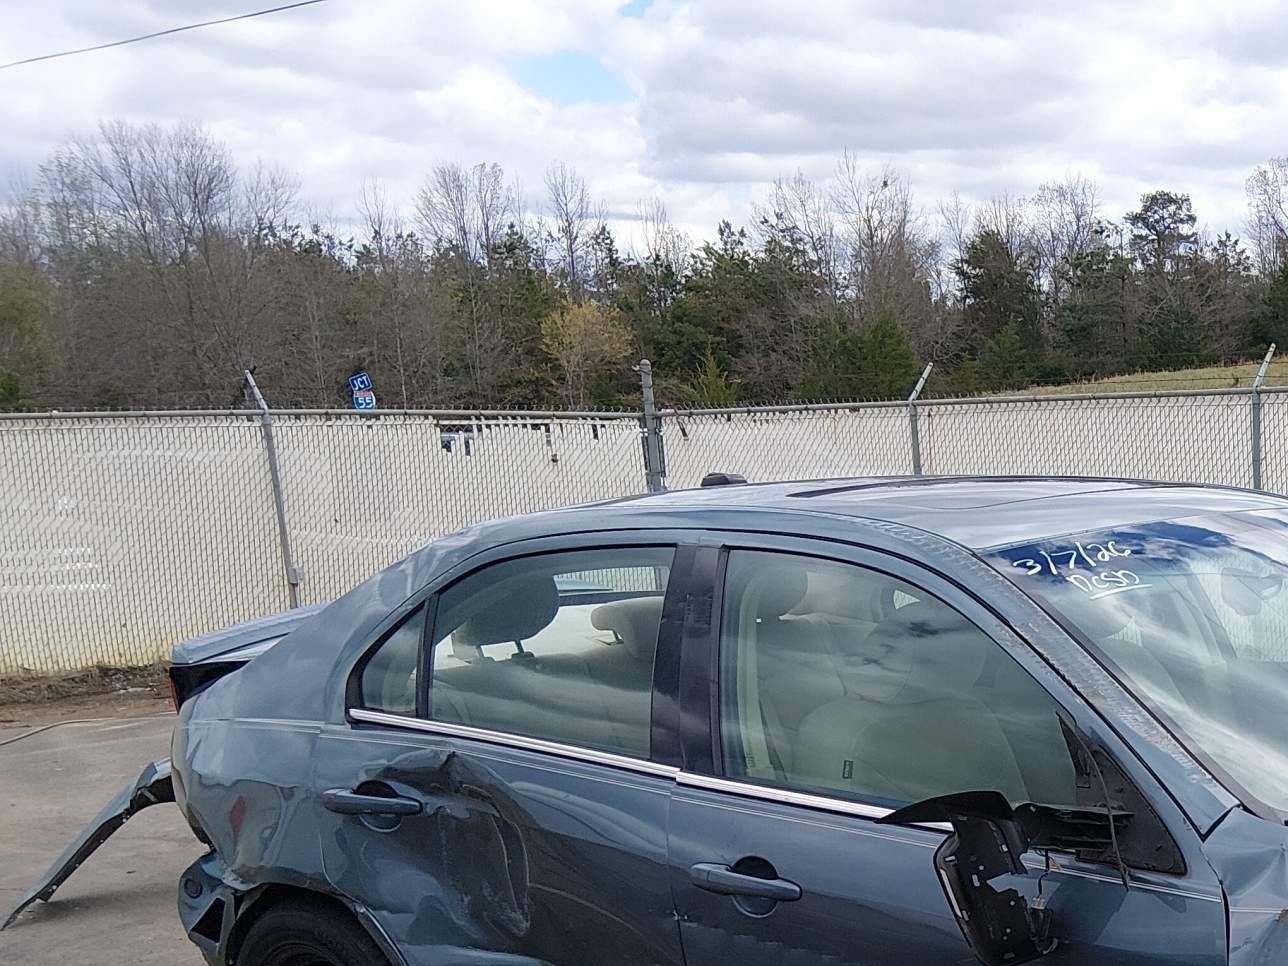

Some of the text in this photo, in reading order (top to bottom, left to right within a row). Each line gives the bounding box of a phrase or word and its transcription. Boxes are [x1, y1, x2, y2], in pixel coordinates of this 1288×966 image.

[353, 376, 369, 390] JCT
[358, 397, 373, 408] 55
[1012, 541, 1131, 575] 3/7/26
